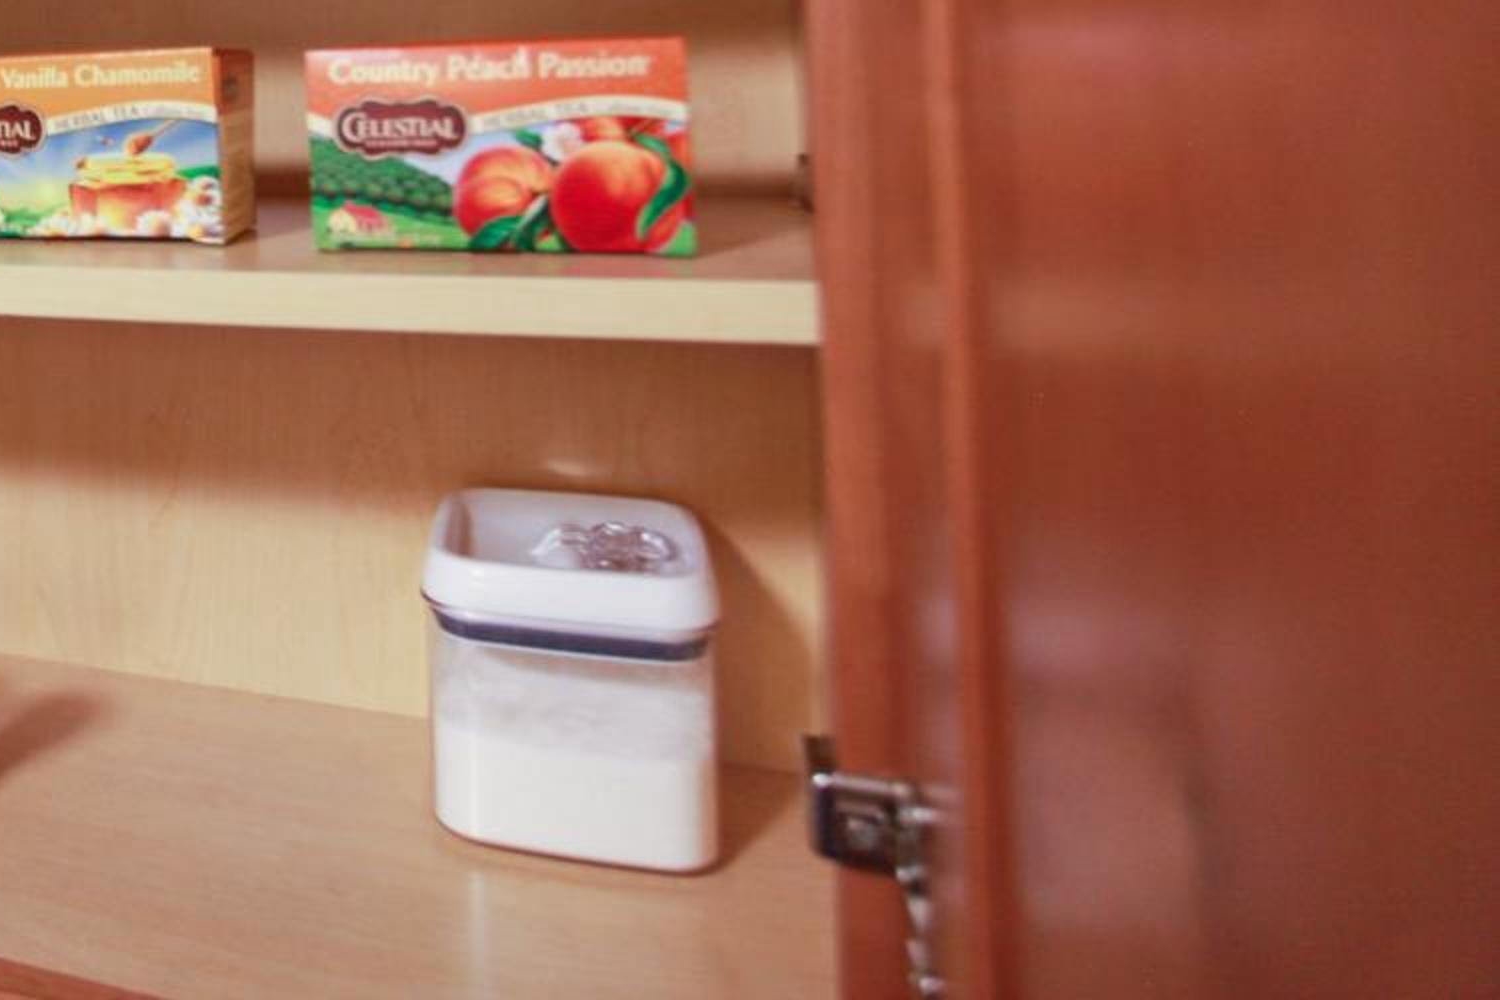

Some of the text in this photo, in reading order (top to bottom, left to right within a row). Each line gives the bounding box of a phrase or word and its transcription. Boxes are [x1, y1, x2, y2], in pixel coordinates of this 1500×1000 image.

[0, 66, 69, 89] Vanilla
[74, 60, 200, 88] Chamomile
[329, 58, 439, 87] Country
[539, 51, 650, 78] Passion
[341, 111, 458, 143] CELESTIAL
